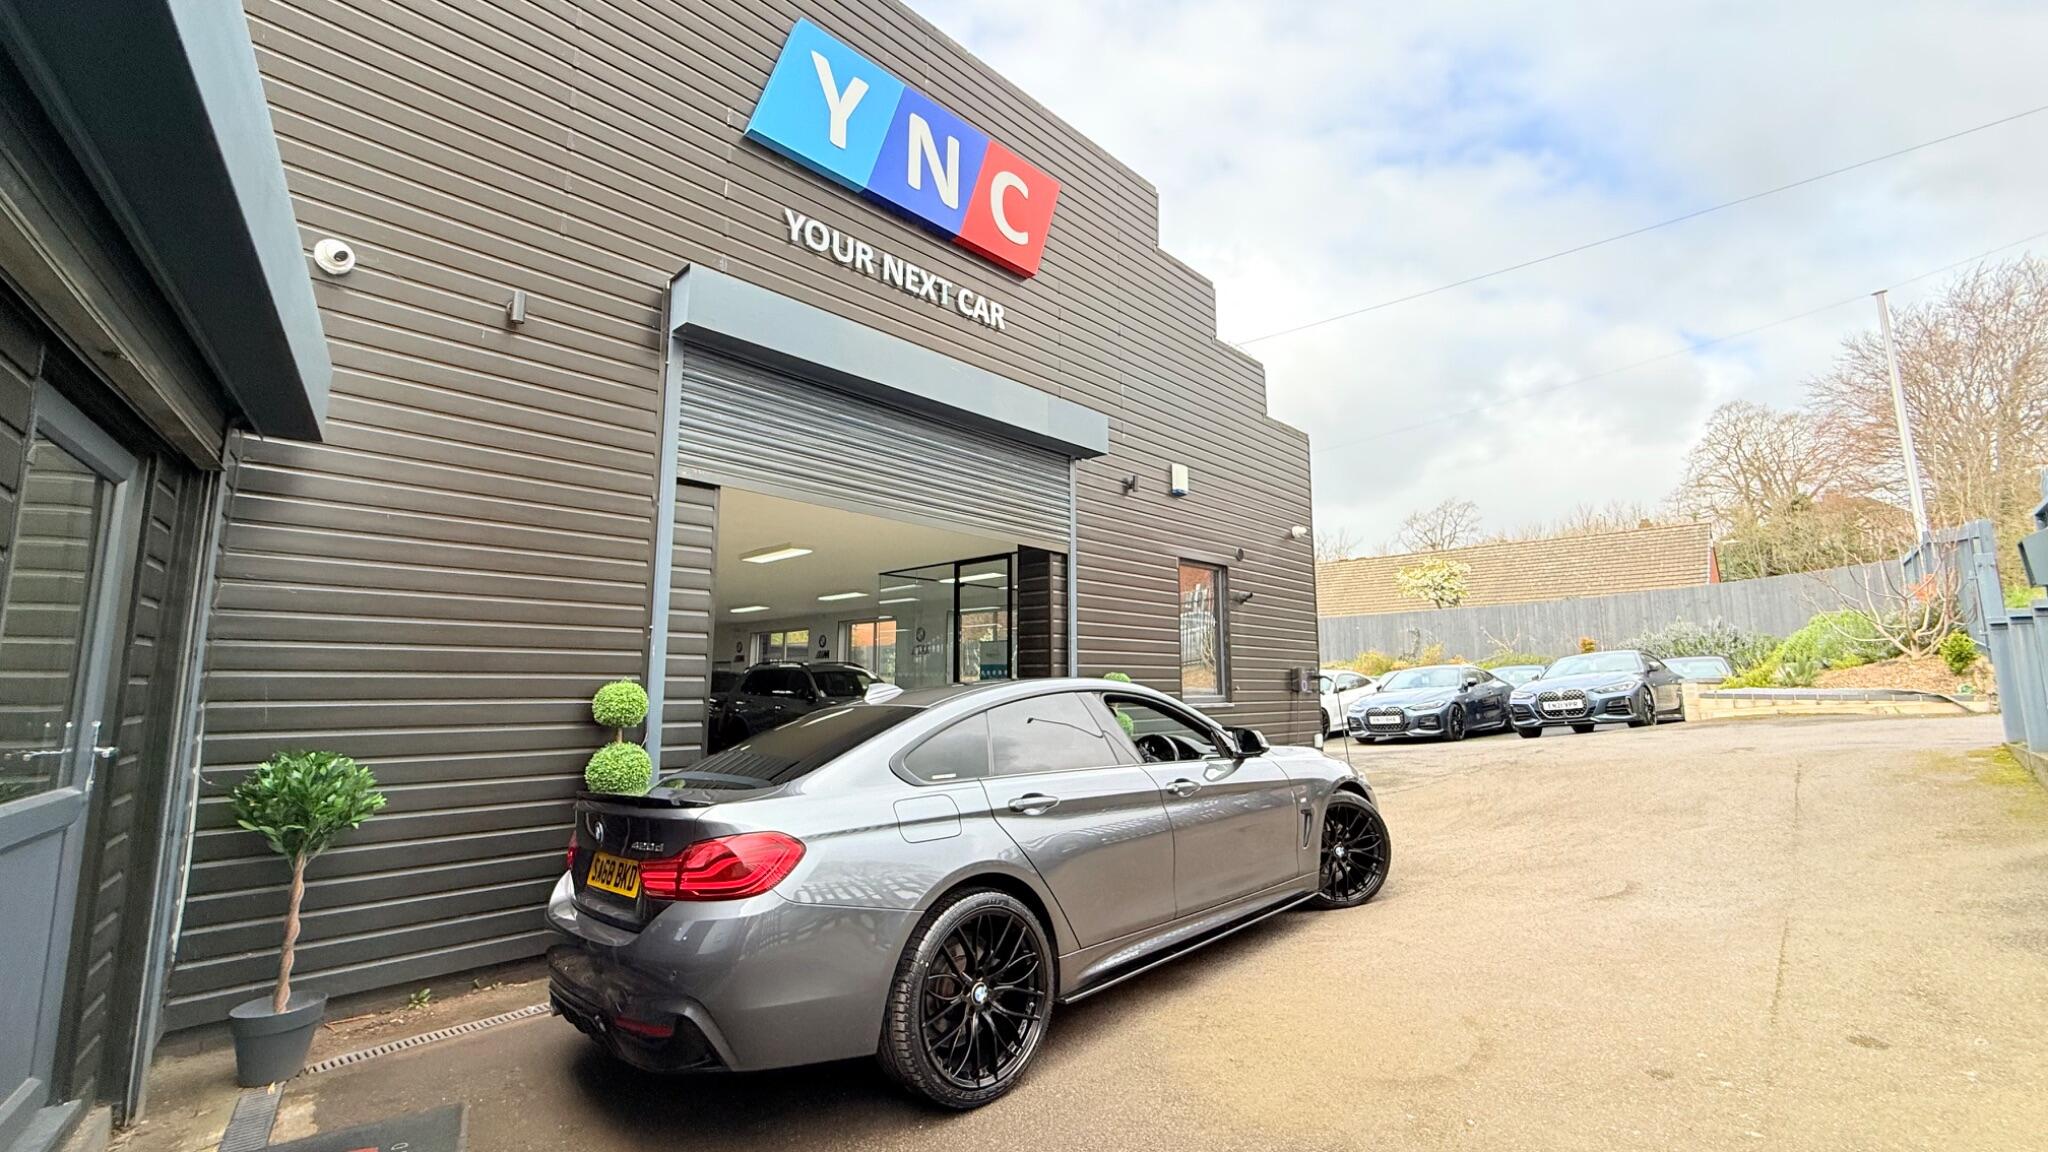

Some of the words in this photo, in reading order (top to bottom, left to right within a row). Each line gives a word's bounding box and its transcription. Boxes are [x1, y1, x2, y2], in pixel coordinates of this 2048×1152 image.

[811, 50, 1029, 246] YNC
[785, 207, 874, 275] YOUR
[883, 259, 952, 306] NEXT
[958, 288, 1005, 330] CAR
[614, 863, 637, 891] BKD
